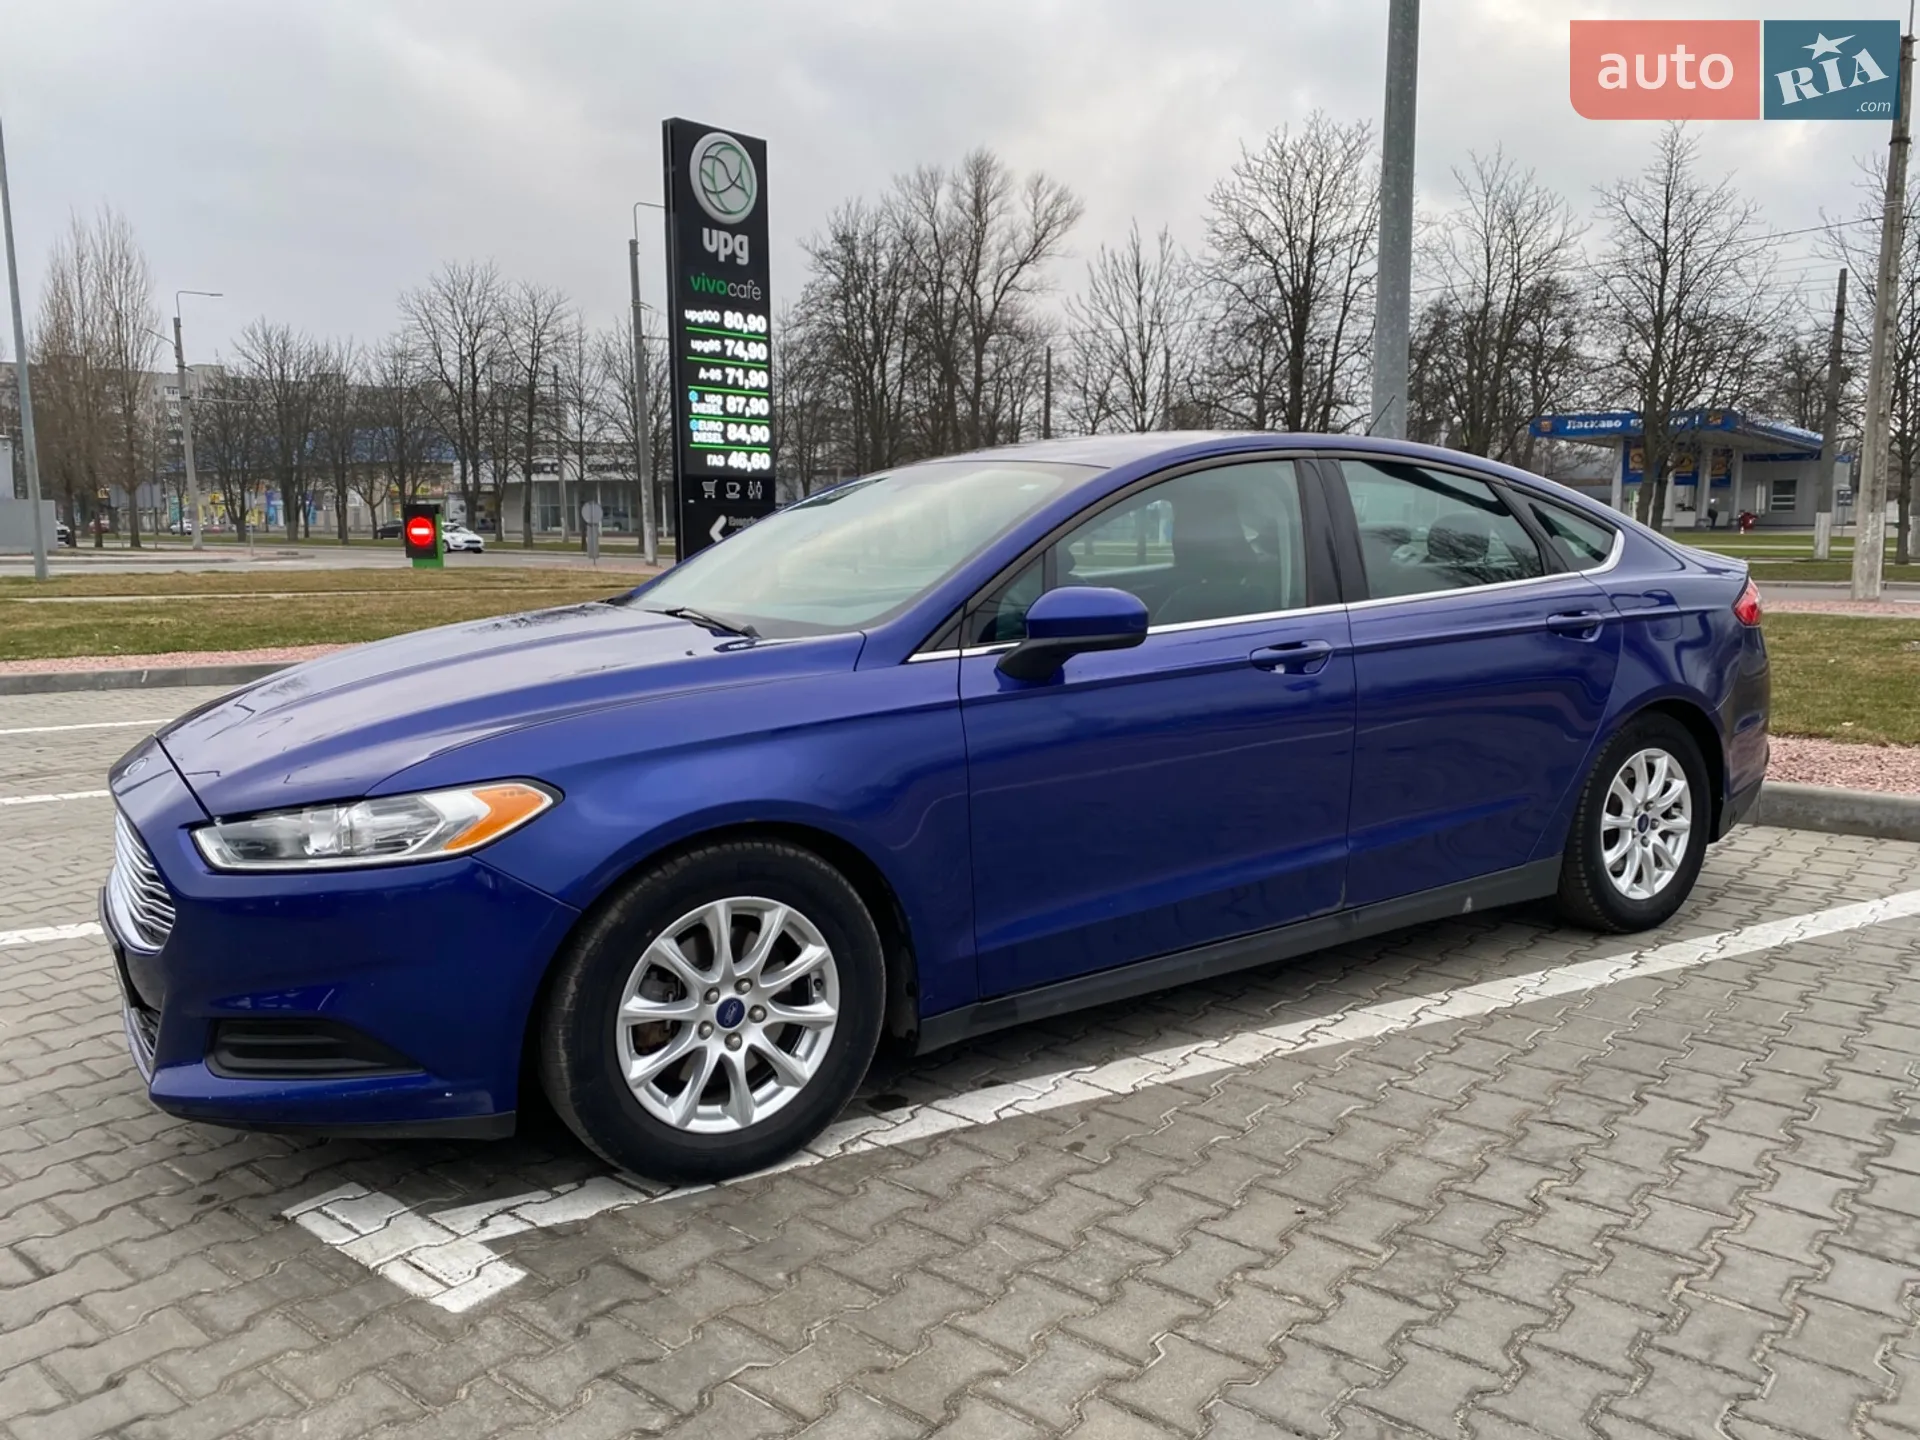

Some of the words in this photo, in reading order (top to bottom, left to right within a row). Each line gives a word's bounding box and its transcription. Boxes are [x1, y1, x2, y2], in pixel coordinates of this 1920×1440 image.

[702, 227, 750, 266] upg
[690, 272, 762, 301] vivocafe
[684, 309, 720, 323] upg100
[723, 310, 767, 333] 80,90
[724, 339, 768, 361] 74,90
[725, 367, 769, 389] 71,90
[691, 402, 724, 415] DIESEL
[726, 395, 769, 417] 87,90
[698, 419, 724, 432] EURO
[727, 423, 770, 445] 84,90
[692, 431, 725, 444] DIESEL
[727, 451, 771, 472] 46,60
